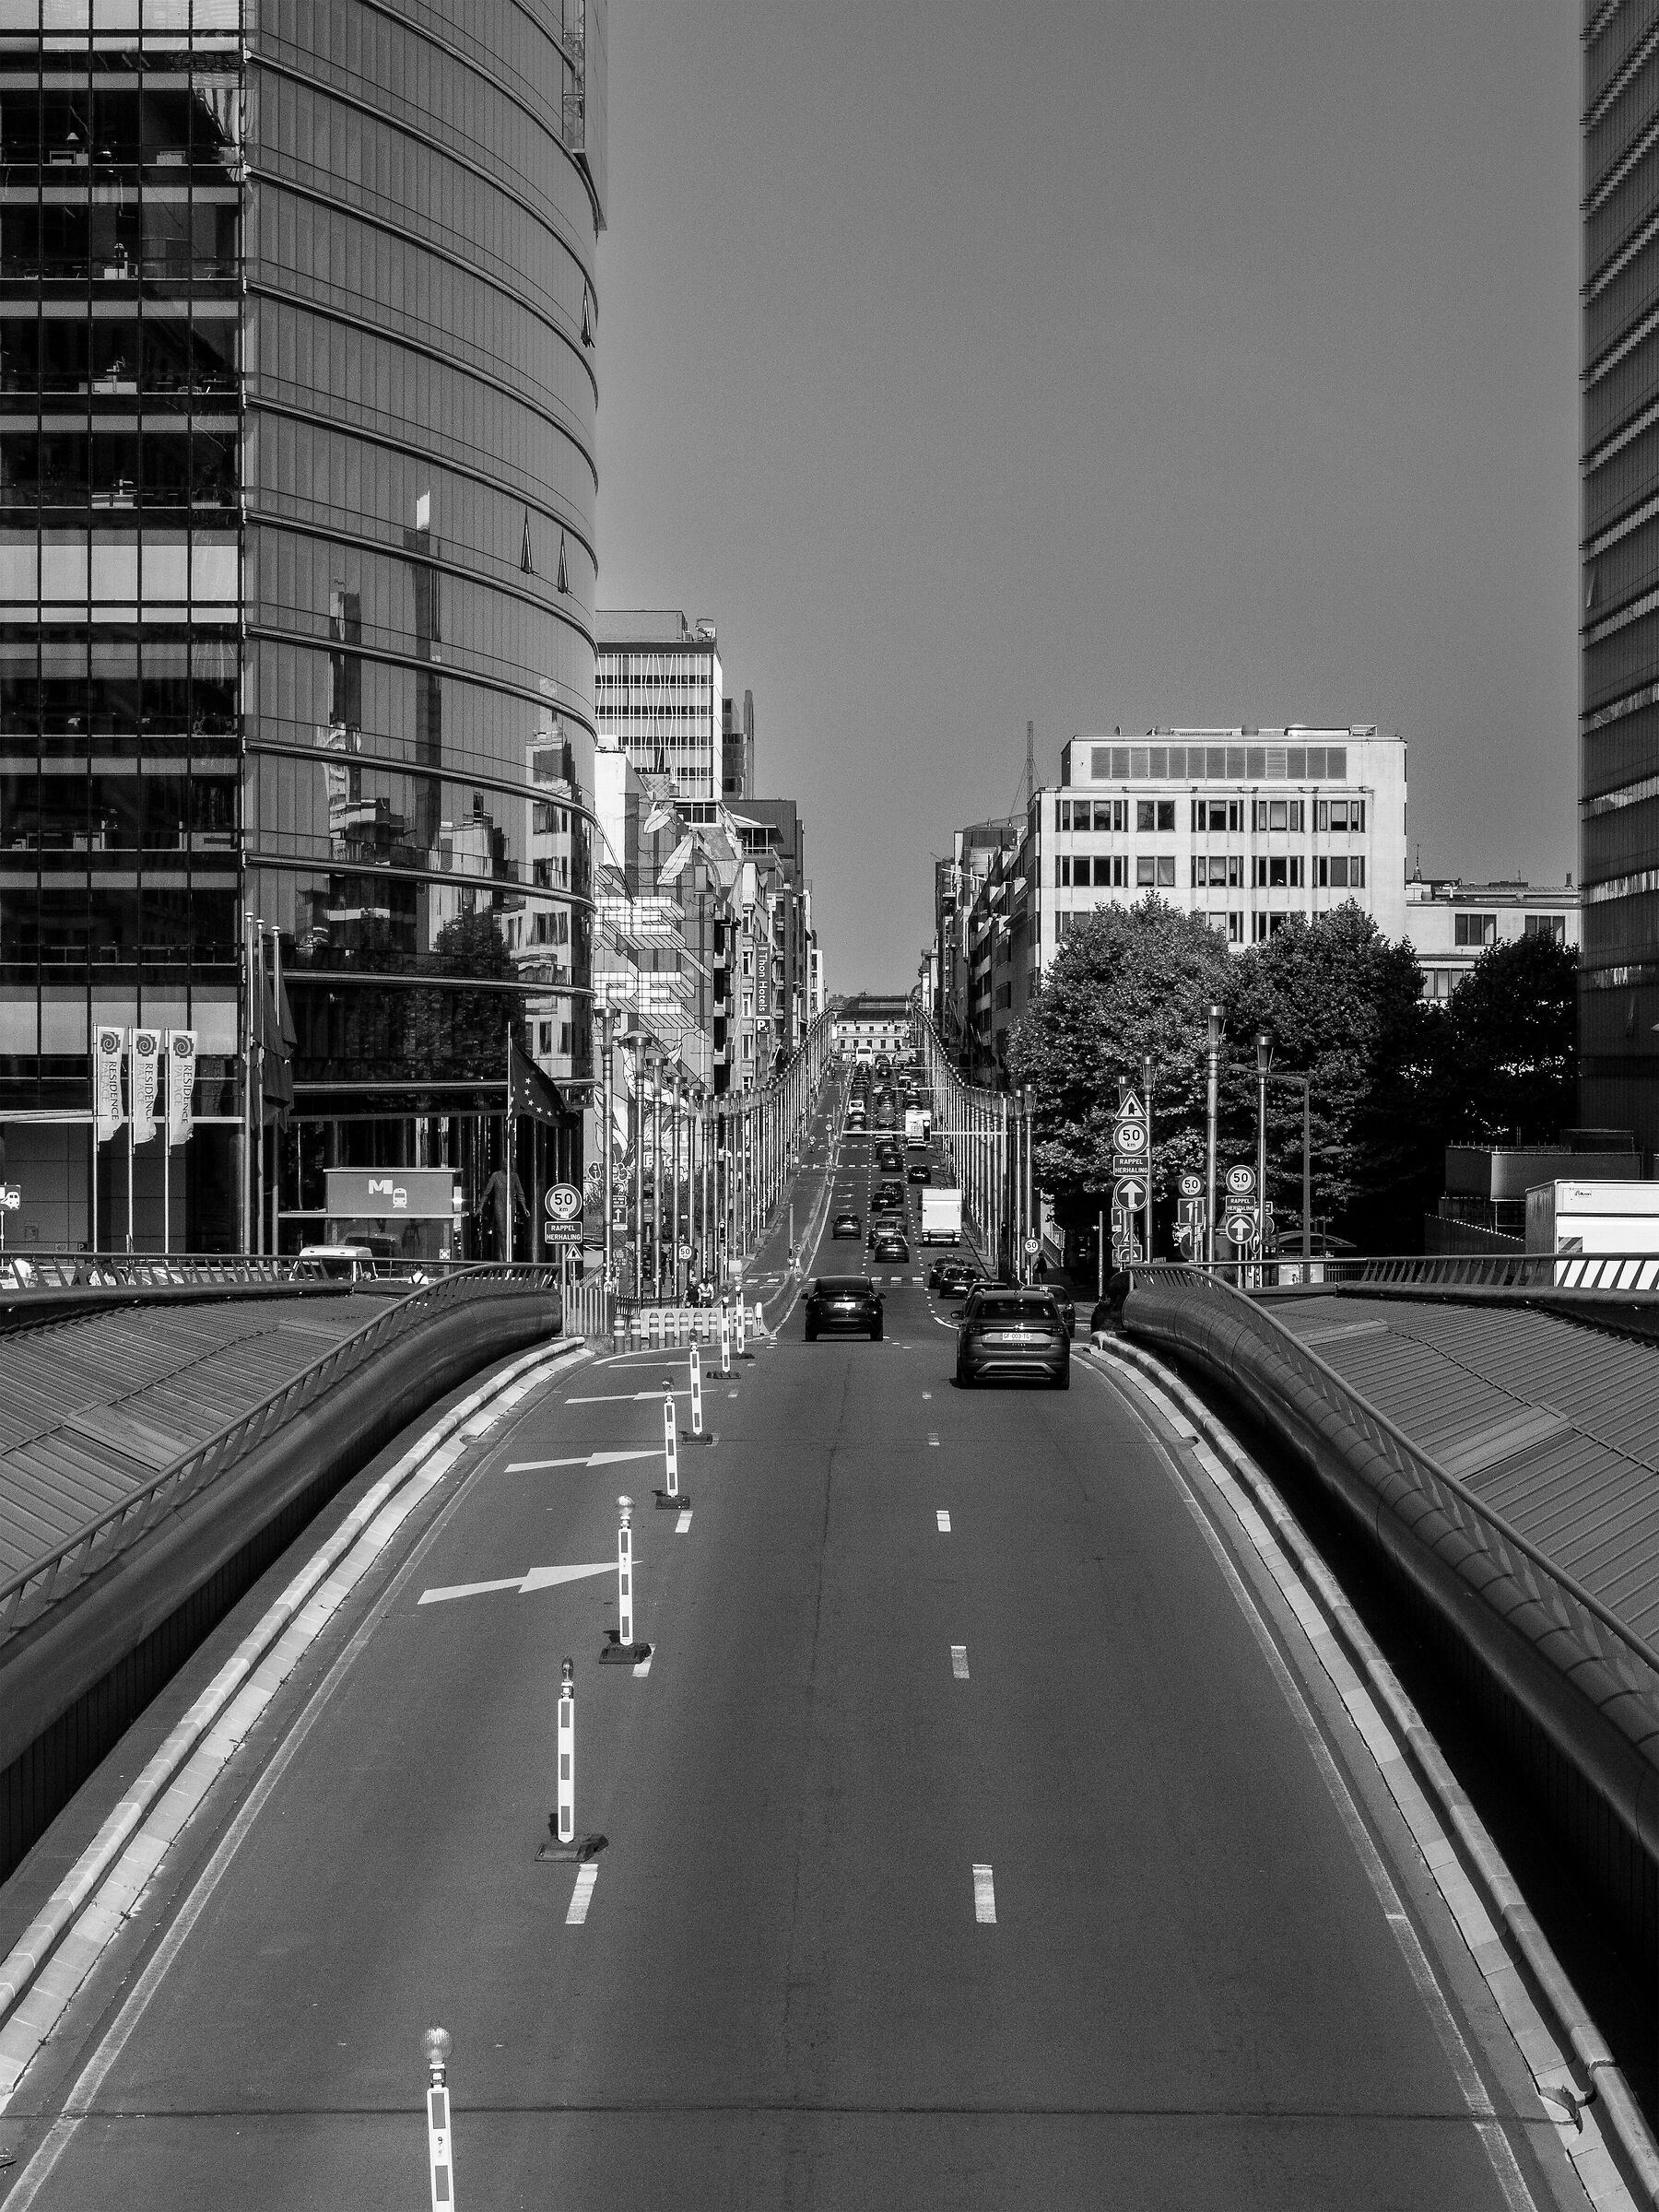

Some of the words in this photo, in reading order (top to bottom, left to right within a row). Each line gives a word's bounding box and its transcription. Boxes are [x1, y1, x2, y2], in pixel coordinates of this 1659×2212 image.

[759, 953, 768, 977] Thon
[759, 981, 768, 1012] Hotels
[757, 1020, 766, 1031] P
[100, 1061, 110, 1102] PALACE
[136, 1063, 145, 1105] PALACE
[173, 1065, 182, 1107] PALACE
[109, 1061, 120, 1121] RESIDENCE
[1123, 1129, 1140, 1141] 50
[1184, 1180, 1198, 1189] 50
[1233, 1172, 1249, 1183] 50
[554, 1193, 573, 1206] 50
[1027, 1241, 1037, 1249] 50
